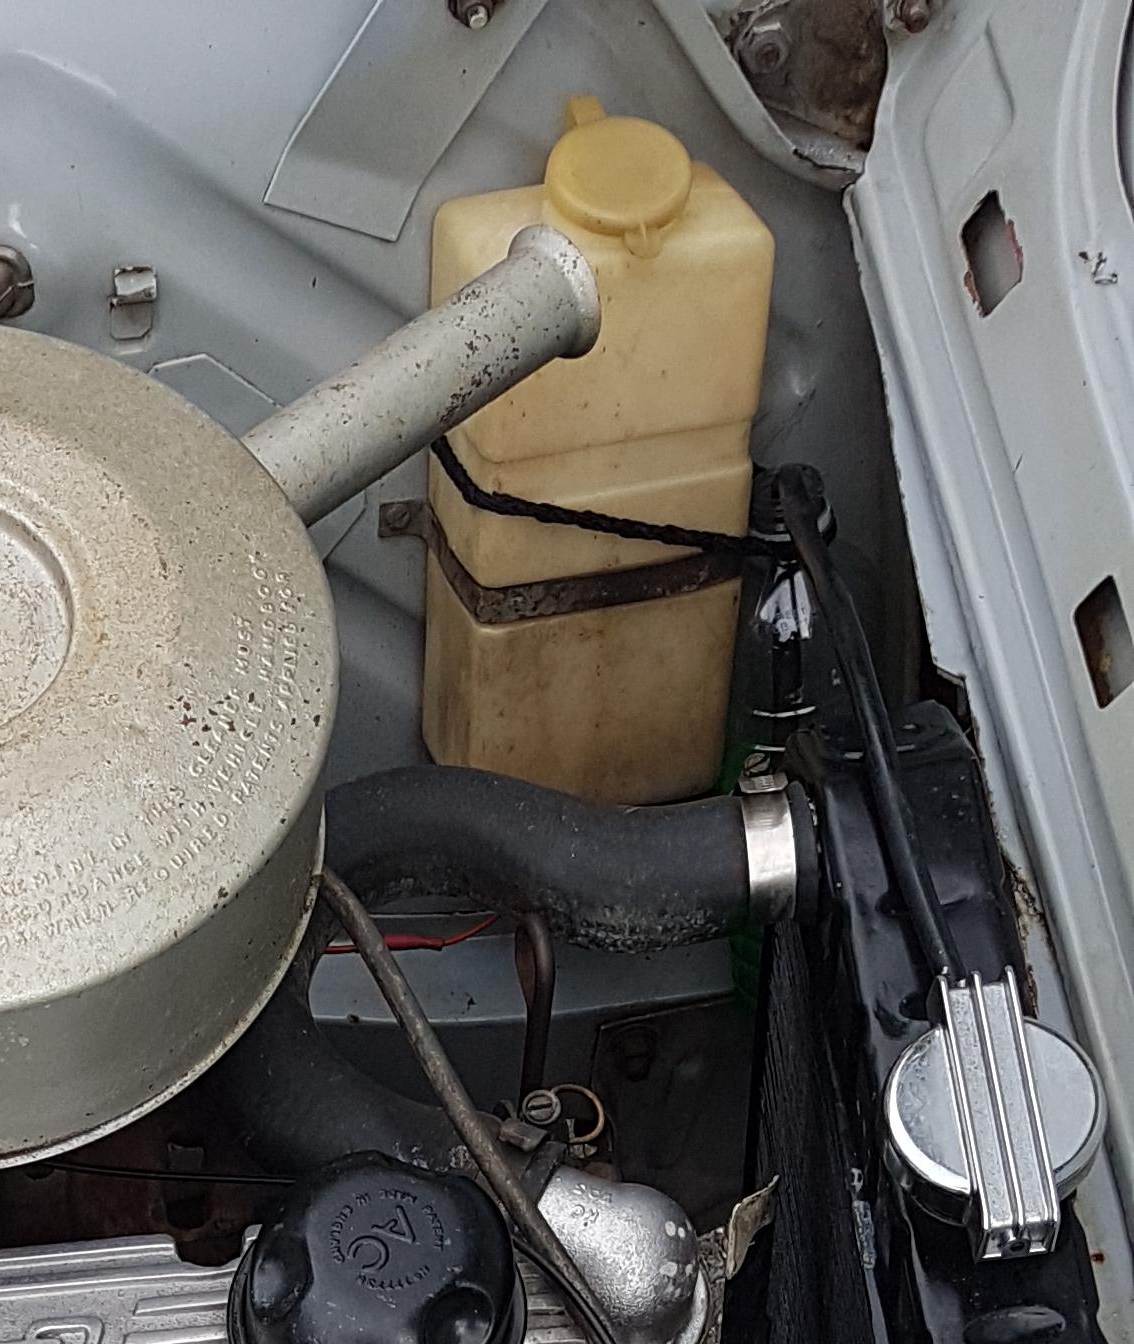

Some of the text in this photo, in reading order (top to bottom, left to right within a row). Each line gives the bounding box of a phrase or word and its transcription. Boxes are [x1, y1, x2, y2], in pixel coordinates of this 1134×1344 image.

[184, 687, 241, 778] CLEANER
[230, 610, 250, 674] MUST
[204, 699, 266, 793] VEHICLE
[226, 719, 285, 805] PATENTS
[345, 1204, 416, 1274] AC
[420, 1204, 444, 1252] PATENT
